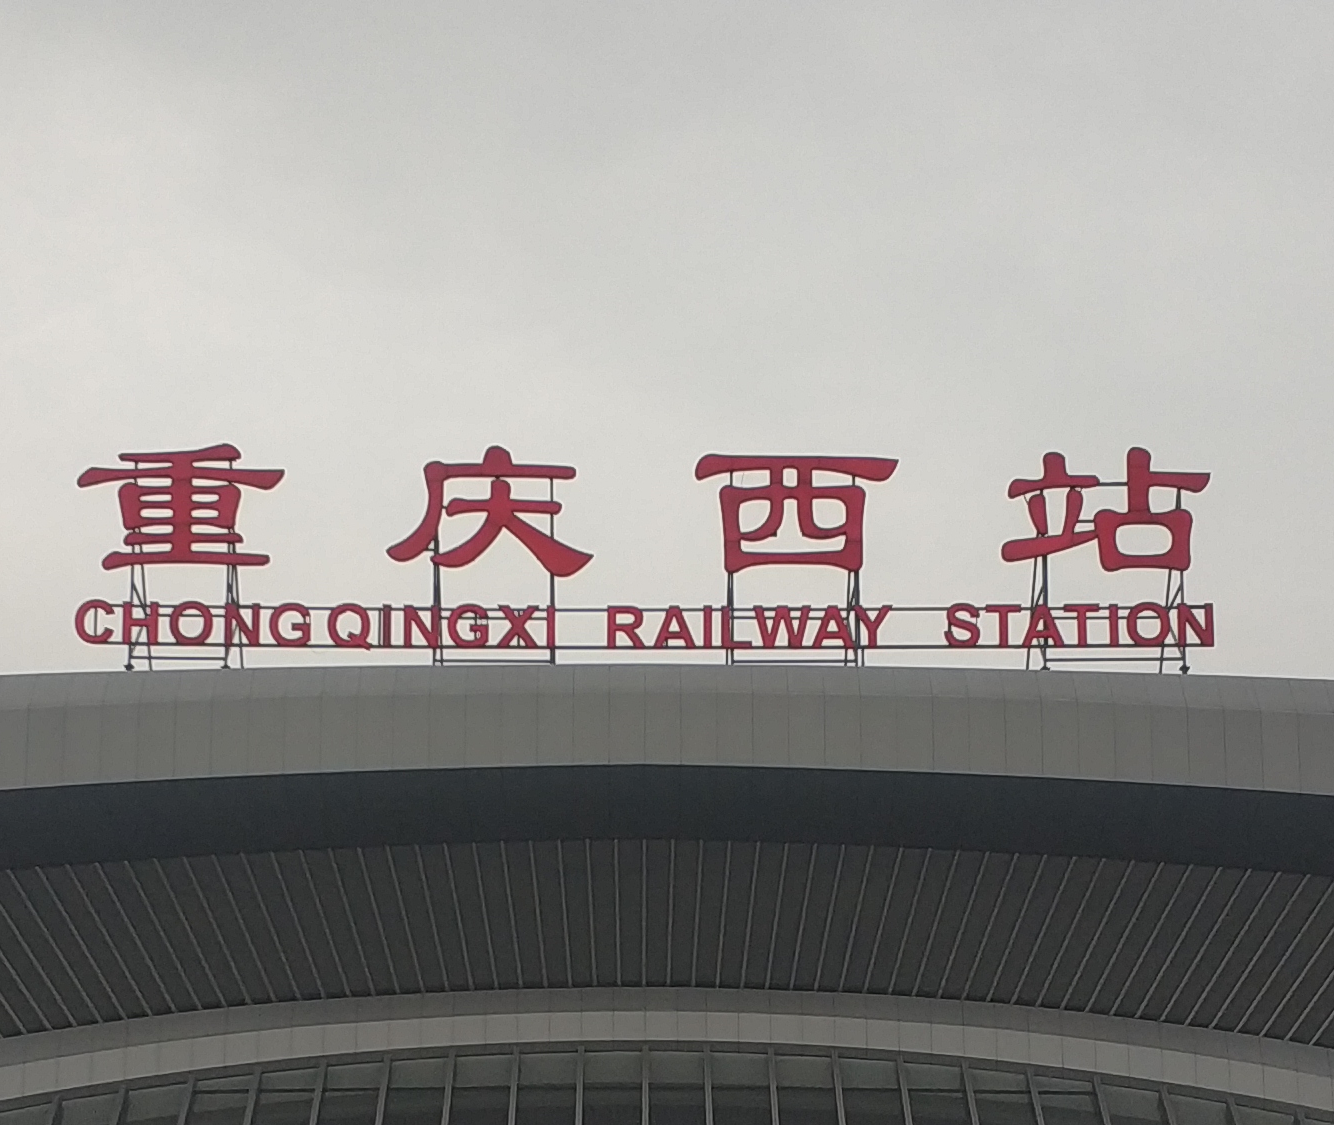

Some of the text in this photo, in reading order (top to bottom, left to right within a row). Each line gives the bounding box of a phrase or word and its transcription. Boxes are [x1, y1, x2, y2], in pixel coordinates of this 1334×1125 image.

[78, 445, 1208, 577] 重庆西站
[75, 602, 1214, 651] CHONGQINGXI RAILWAY STATION
